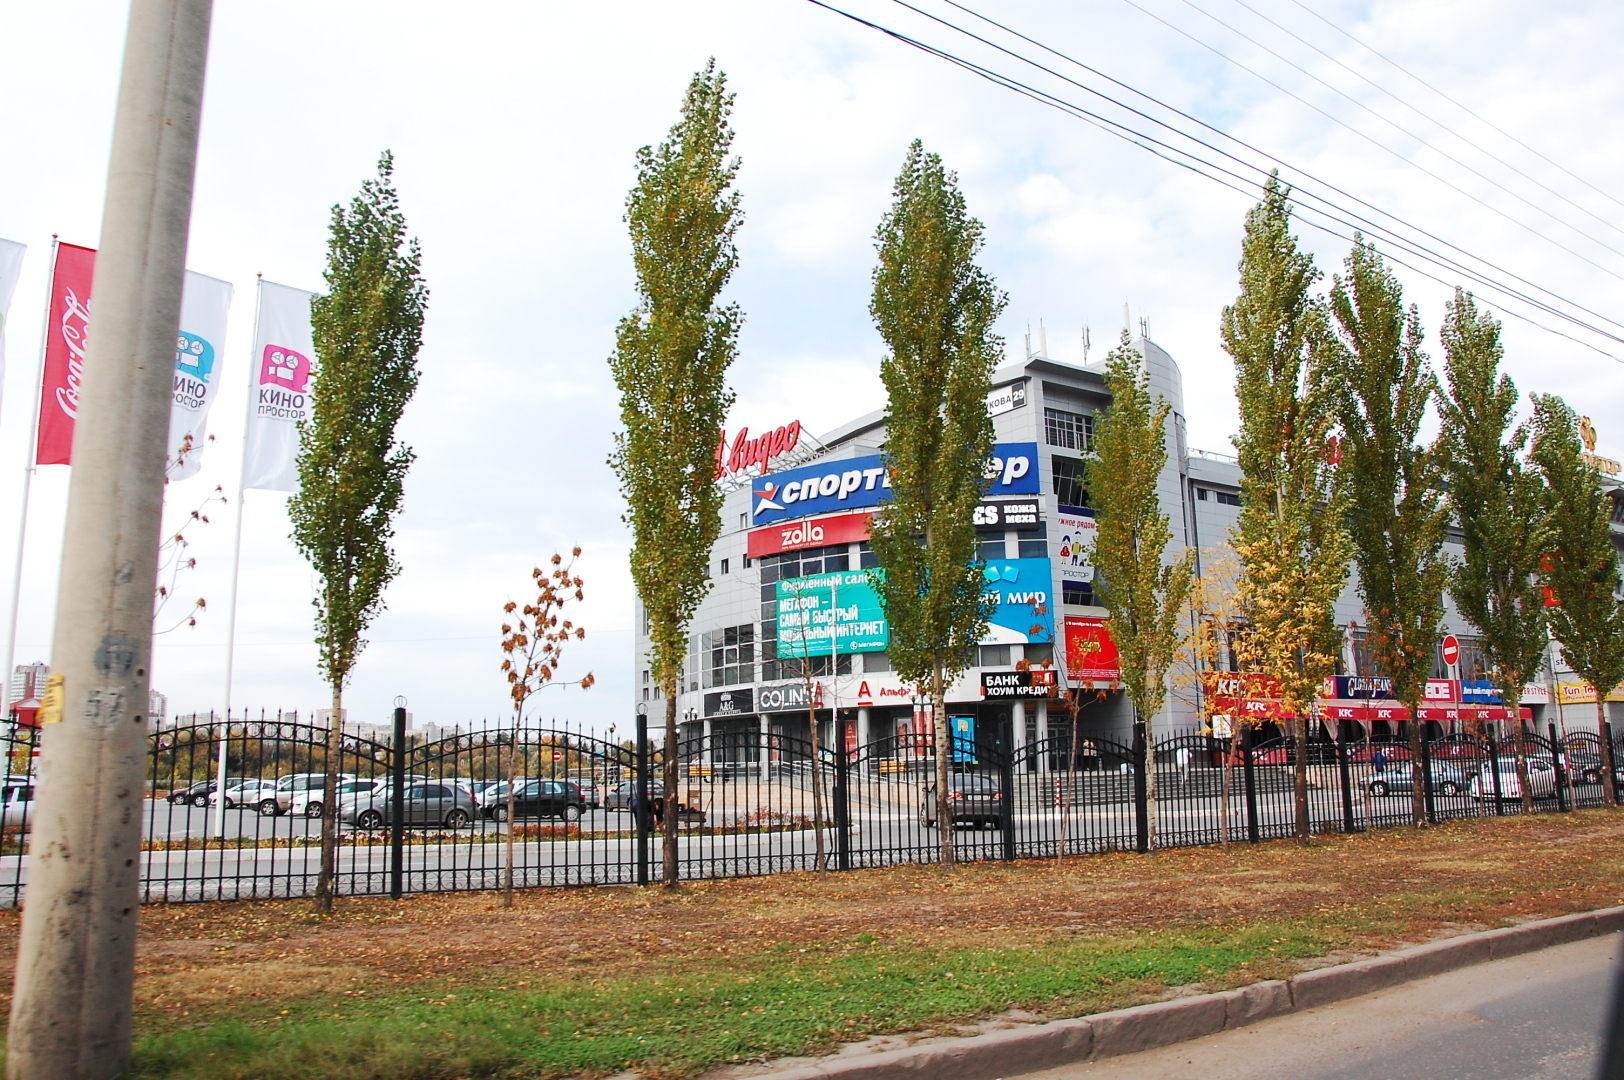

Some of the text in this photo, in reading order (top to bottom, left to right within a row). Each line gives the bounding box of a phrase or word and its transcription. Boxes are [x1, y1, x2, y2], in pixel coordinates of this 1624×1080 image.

[174, 376, 206, 399] ИНО
[171, 393, 205, 408] ОСТОР
[259, 389, 305, 409] КИНО
[985, 389, 1024, 410] КОВА 29
[257, 405, 306, 419] ПРОСТОР
[781, 521, 824, 546] zolla
[780, 595, 819, 612] МЕГАФОН
[1007, 591, 1046, 609] мир
[780, 604, 858, 628] САМЫЙ БЫСРЫЙ
[836, 620, 885, 638] ИНТЕРНЕТ
[986, 675, 1020, 687] БАНК
[987, 686, 1015, 696] ХОУМ
[719, 701, 734, 711] A&G
[1246, 702, 1267, 711] KFC
[1338, 709, 1353, 718] KFC
[1378, 709, 1392, 718] KFC
[1478, 711, 1489, 719] KFC
